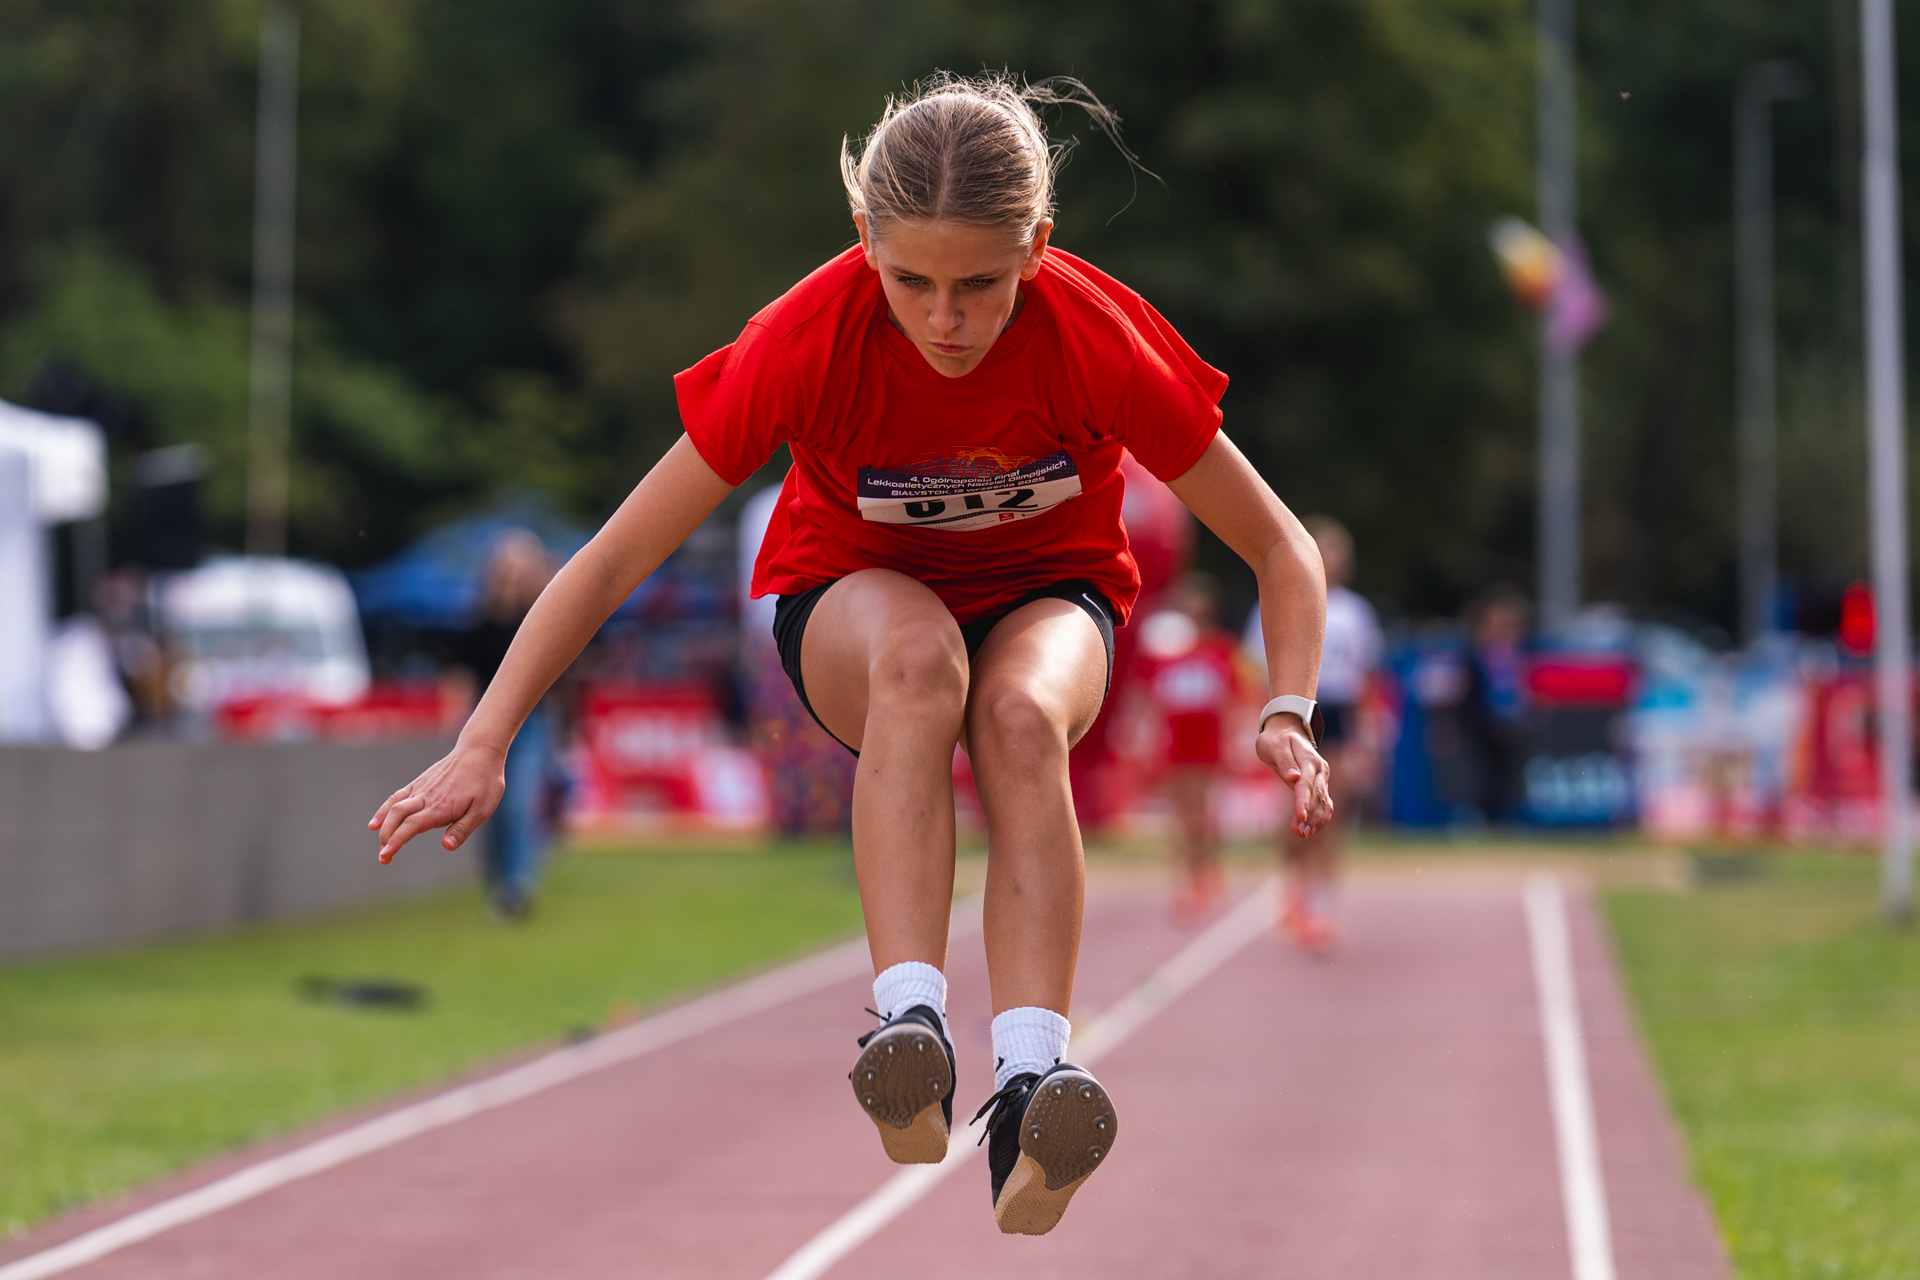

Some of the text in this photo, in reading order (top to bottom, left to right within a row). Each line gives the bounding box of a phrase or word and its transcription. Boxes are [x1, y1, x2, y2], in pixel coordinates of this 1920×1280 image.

[867, 460, 1067, 490] Lekkoatletycznych Nadziei Olimpijskich
[922, 476, 992, 485] Ogólnopolski
[995, 469, 1020, 481] Finał
[966, 483, 1015, 492] września
[1017, 475, 1045, 485] 2025
